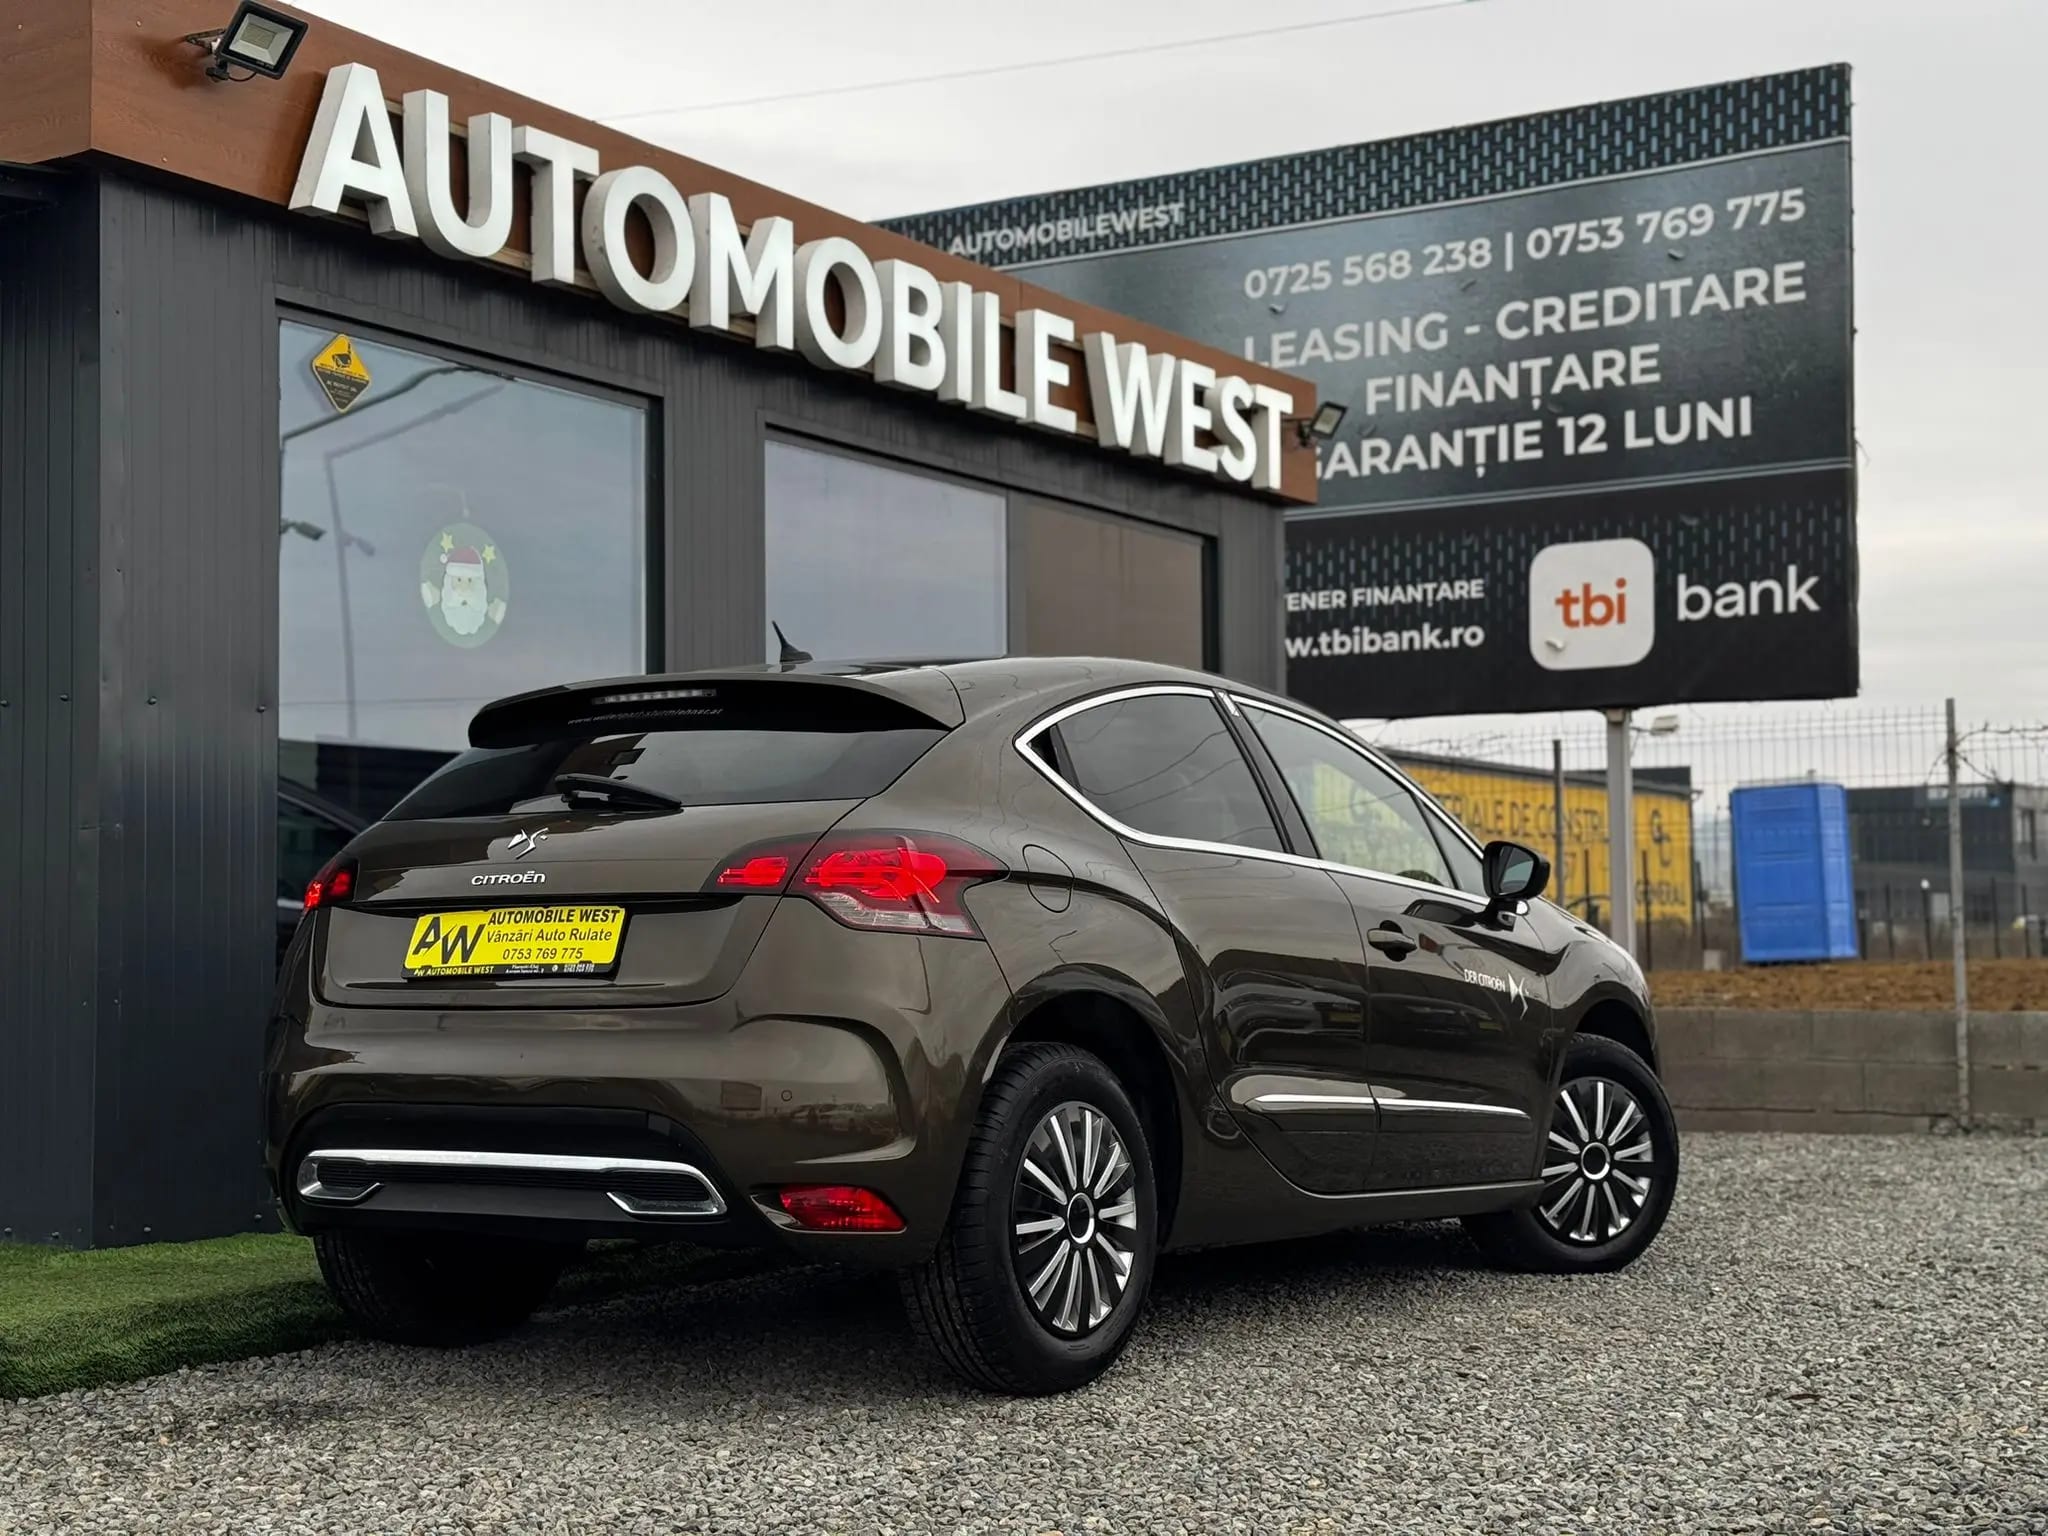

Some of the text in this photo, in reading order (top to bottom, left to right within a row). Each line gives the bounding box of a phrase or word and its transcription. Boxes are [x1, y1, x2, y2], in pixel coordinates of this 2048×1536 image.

[949, 203, 1185, 256] AUTOMOBILEWEST
[1245, 259, 1331, 299] 0725
[1342, 249, 1412, 287] 568
[1422, 239, 1492, 276] 238
[1526, 223, 1624, 261] 0753
[1637, 203, 1714, 243] 769
[1726, 188, 1806, 231] 775
[288, 62, 1294, 491] AUTOMOBILE WEST
[1245, 313, 1447, 368] LEASING
[1497, 262, 1806, 342] CREDITARE
[1365, 344, 1661, 415] FINANȚARE
[1315, 396, 1753, 480] ARANȚIE 12 LUNI
[1284, 589, 1346, 611] ENER
[1555, 565, 1820, 628] tbi bank
[488, 909, 620, 926] AUTOMOBILE WEST
[535, 929, 566, 942] Auto
[569, 927, 612, 942] Rulate
[426, 966, 473, 977] AUTOMOBILE
[473, 965, 495, 975] WEST
[503, 946, 583, 960] 0753 769 775
